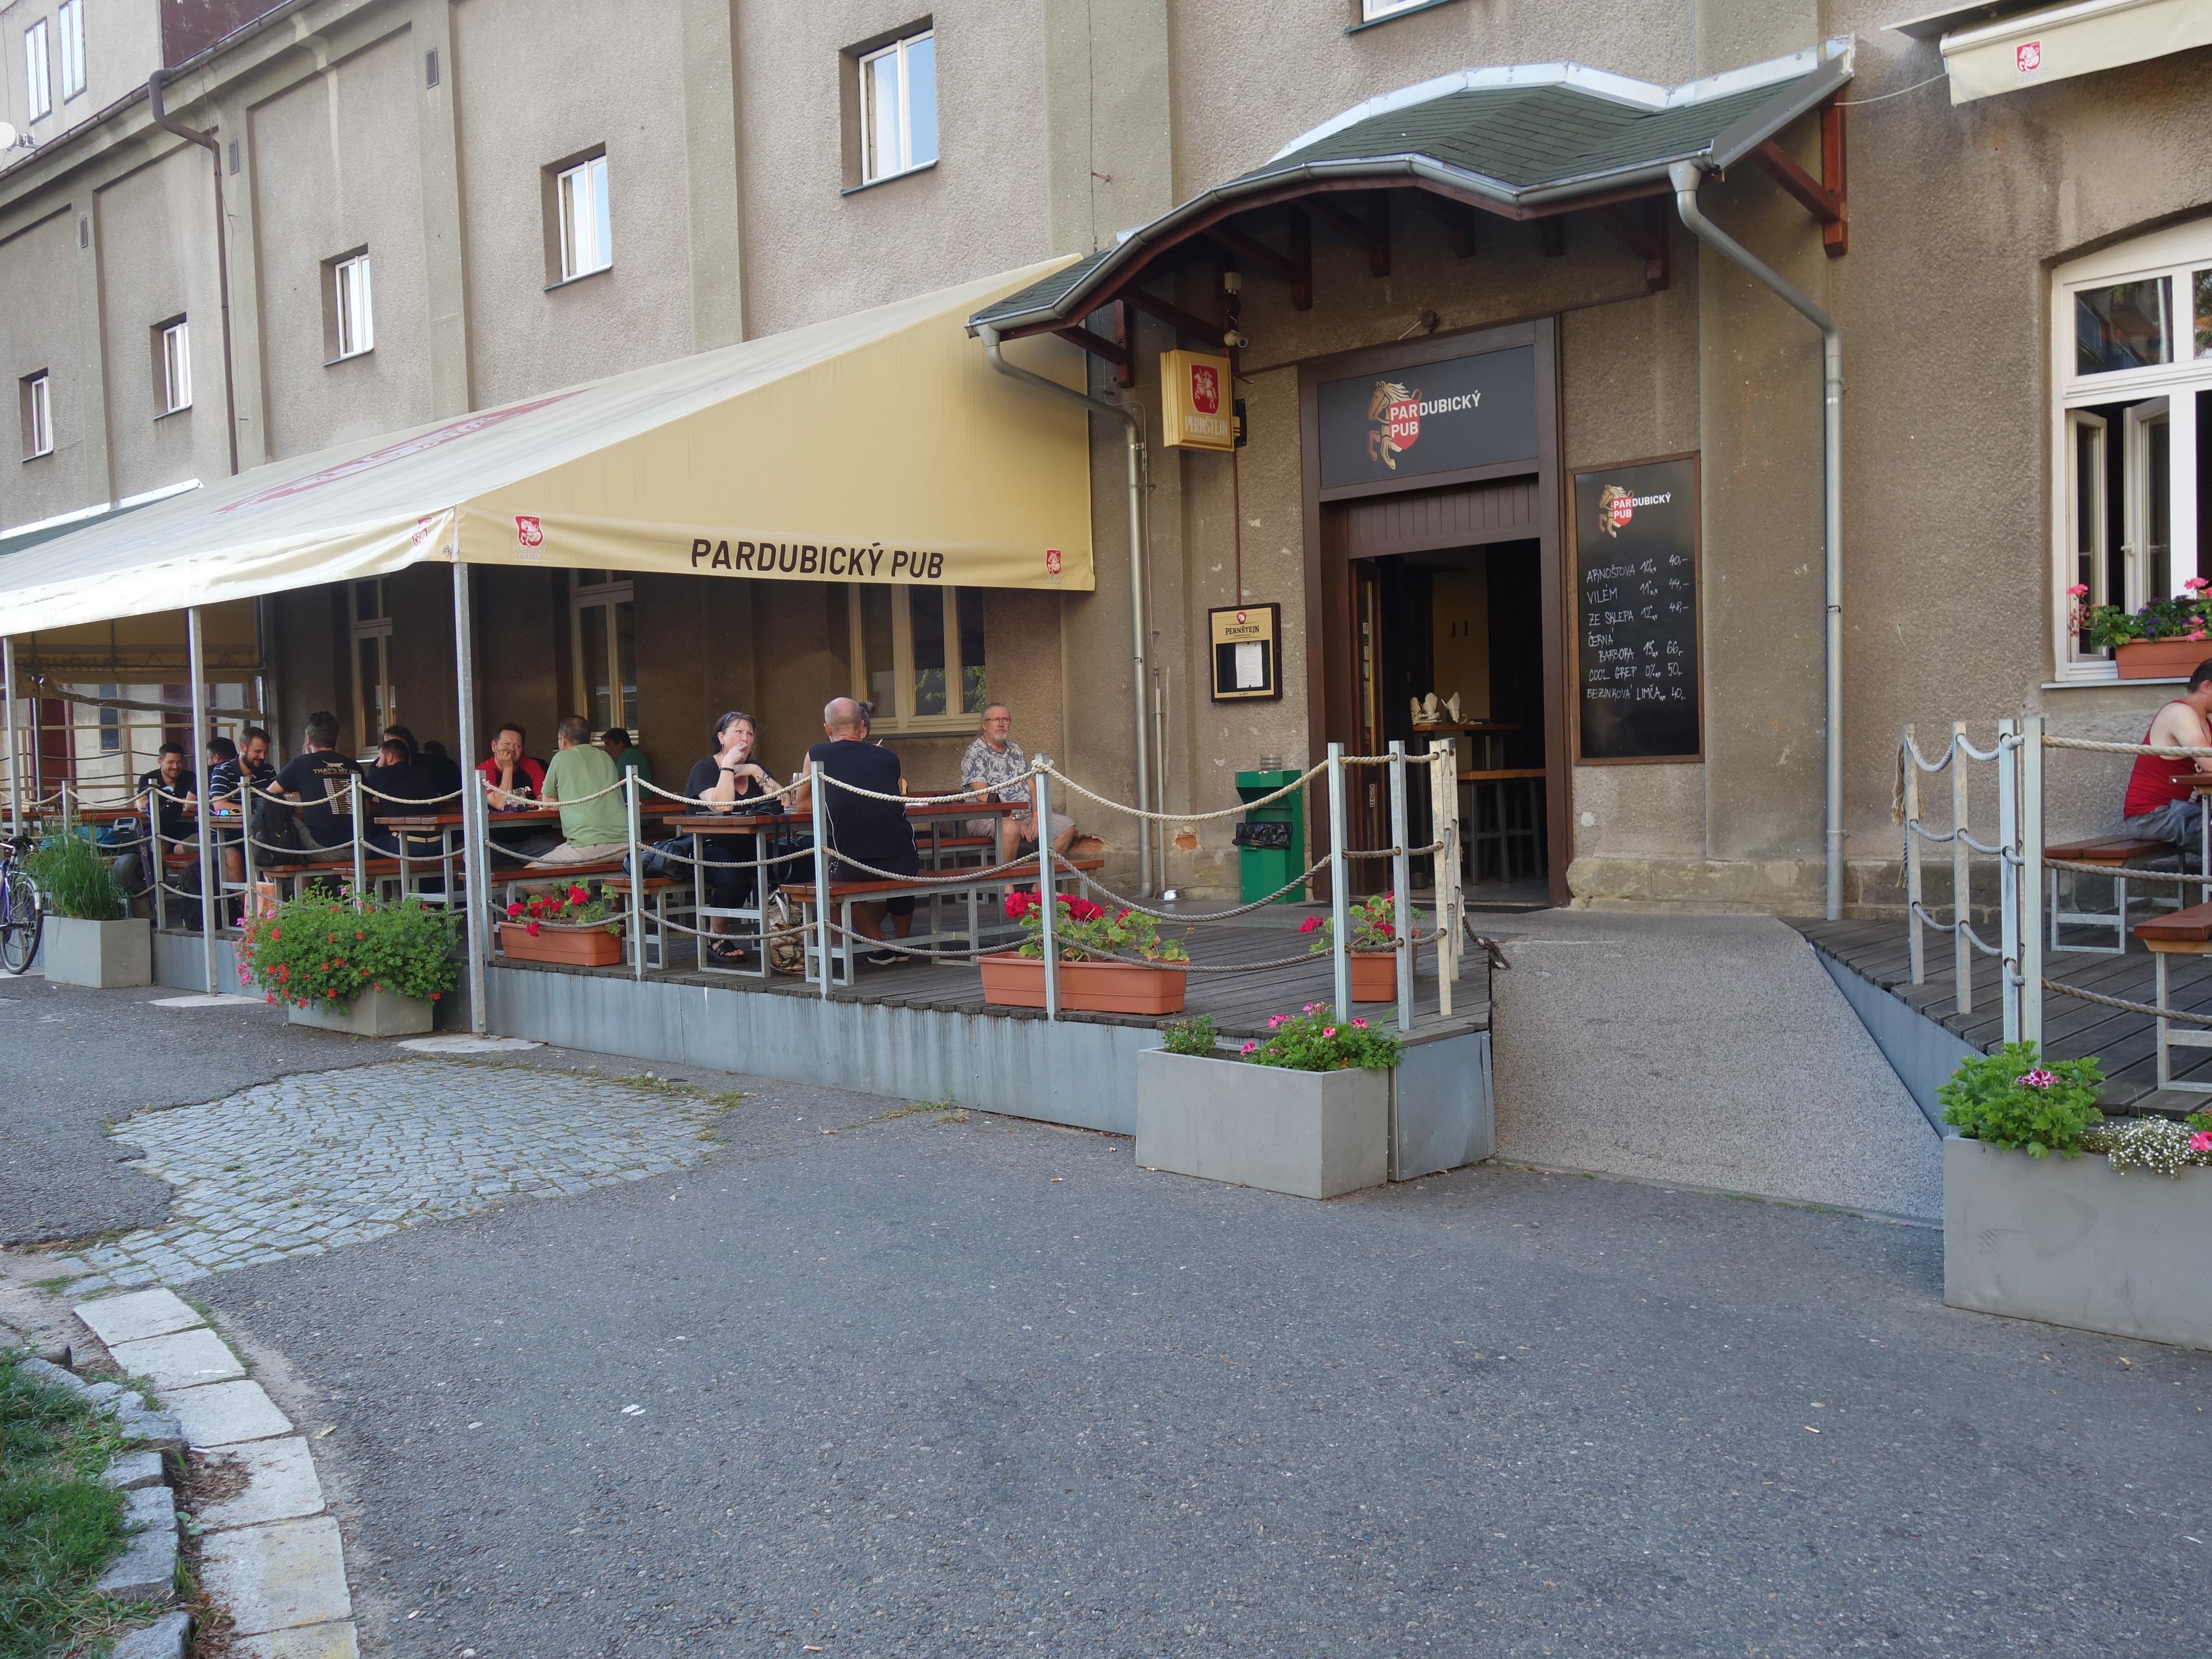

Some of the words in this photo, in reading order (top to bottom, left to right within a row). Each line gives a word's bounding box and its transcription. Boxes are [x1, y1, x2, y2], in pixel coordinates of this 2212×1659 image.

[1390, 390, 1481, 421] PARDUBICKÝ
[1391, 421, 1418, 439] PUB
[1614, 492, 1671, 509] PARDUBICKÝ
[1614, 509, 1632, 519] PUB
[691, 538, 884, 576] PARDUBICKÝ
[891, 550, 944, 580] PUB
[1587, 583, 1618, 604] VILÉM
[1588, 613, 1601, 626] ZE
[1605, 610, 1634, 625] SKLEPA
[1225, 625, 1260, 635] PERNŠTEJN
[1598, 648, 1635, 663] BARBORA
[1589, 669, 1610, 682] COOL
[1615, 666, 1637, 681] GREP
